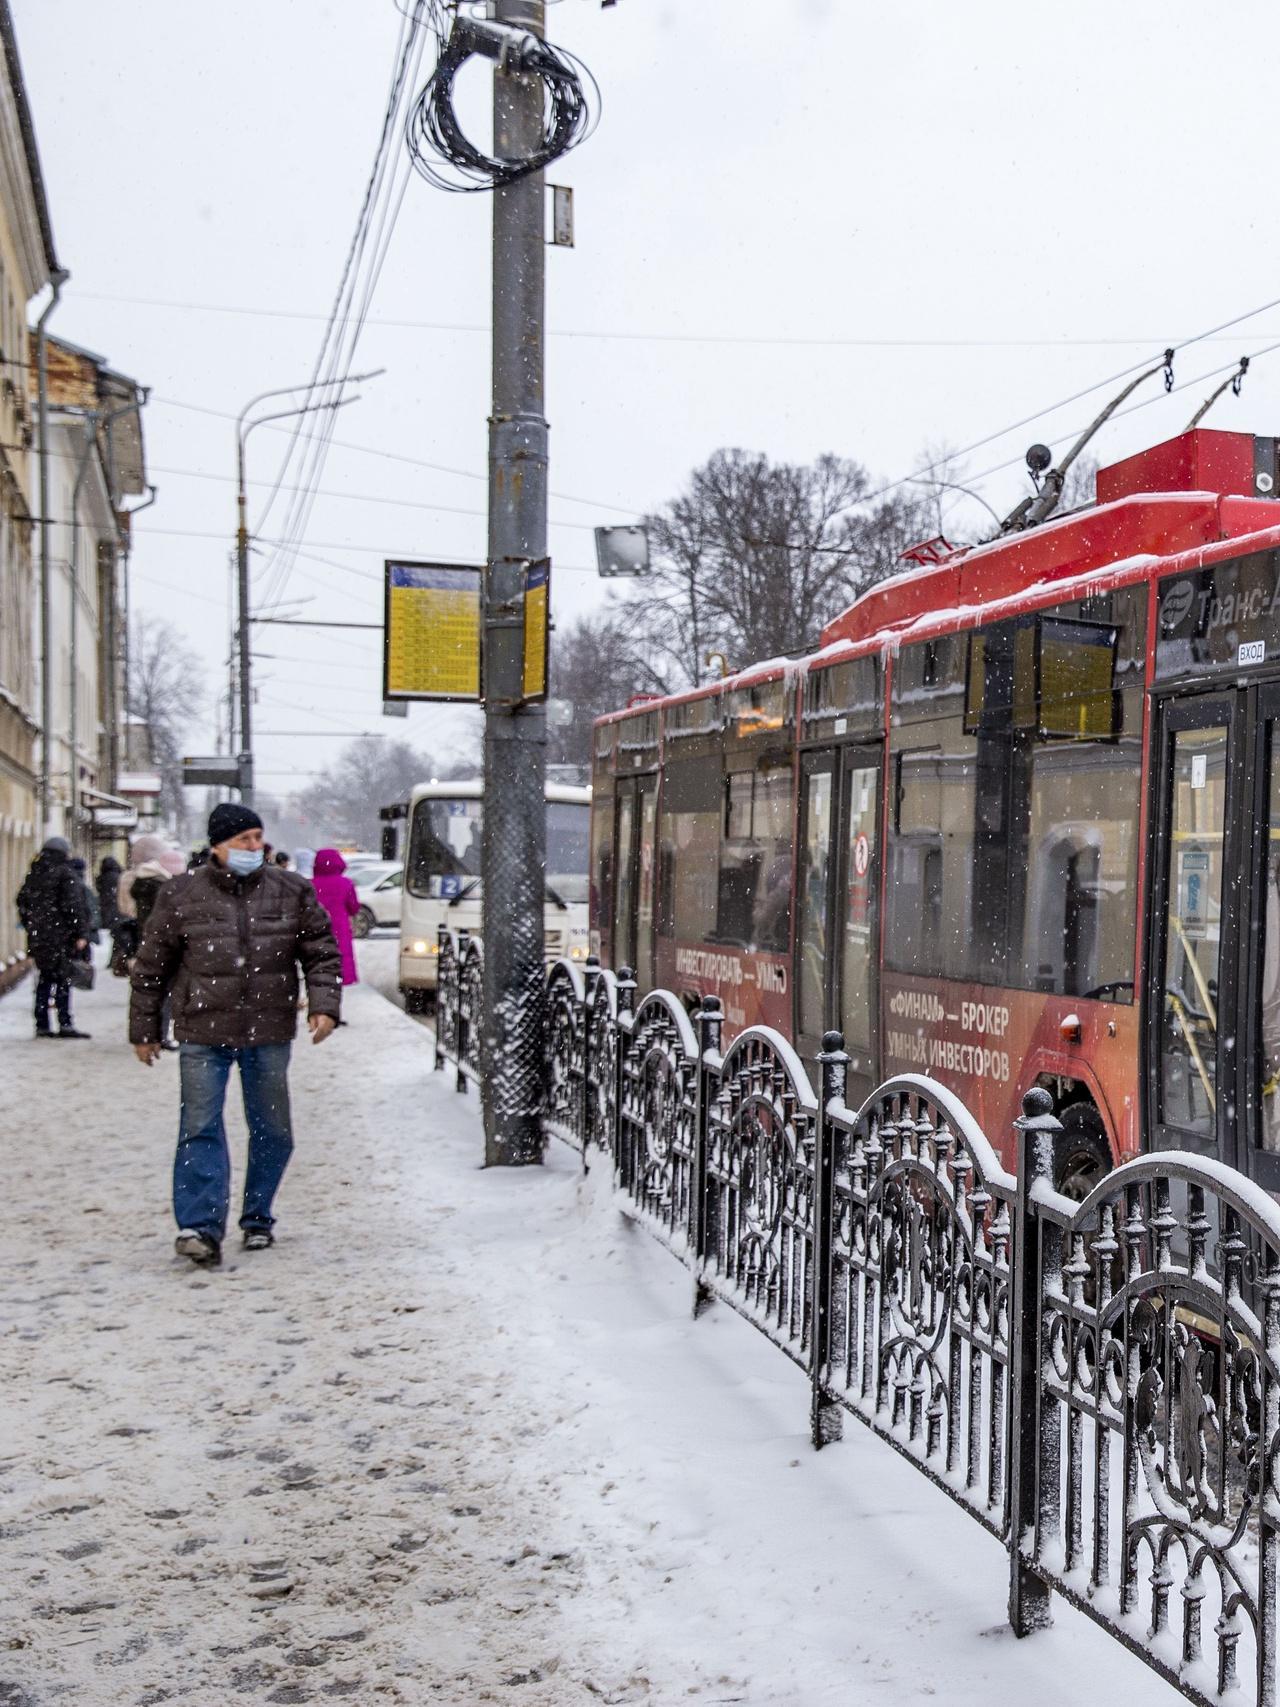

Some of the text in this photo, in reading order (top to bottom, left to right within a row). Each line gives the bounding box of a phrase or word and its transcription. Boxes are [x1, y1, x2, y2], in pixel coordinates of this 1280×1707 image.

[1239, 644, 1264, 662] ВХОД
[445, 879, 457, 894] 2
[675, 948, 743, 985] ИНВЕСТИРОВАТЬ
[756, 960, 788, 994] УМНО
[889, 991, 944, 1022] «ФИНАМ»
[961, 1001, 1009, 1036] БРОКЕР
[888, 1031, 1010, 1082] УМНЫХ ИНВЕСТОРОВ
